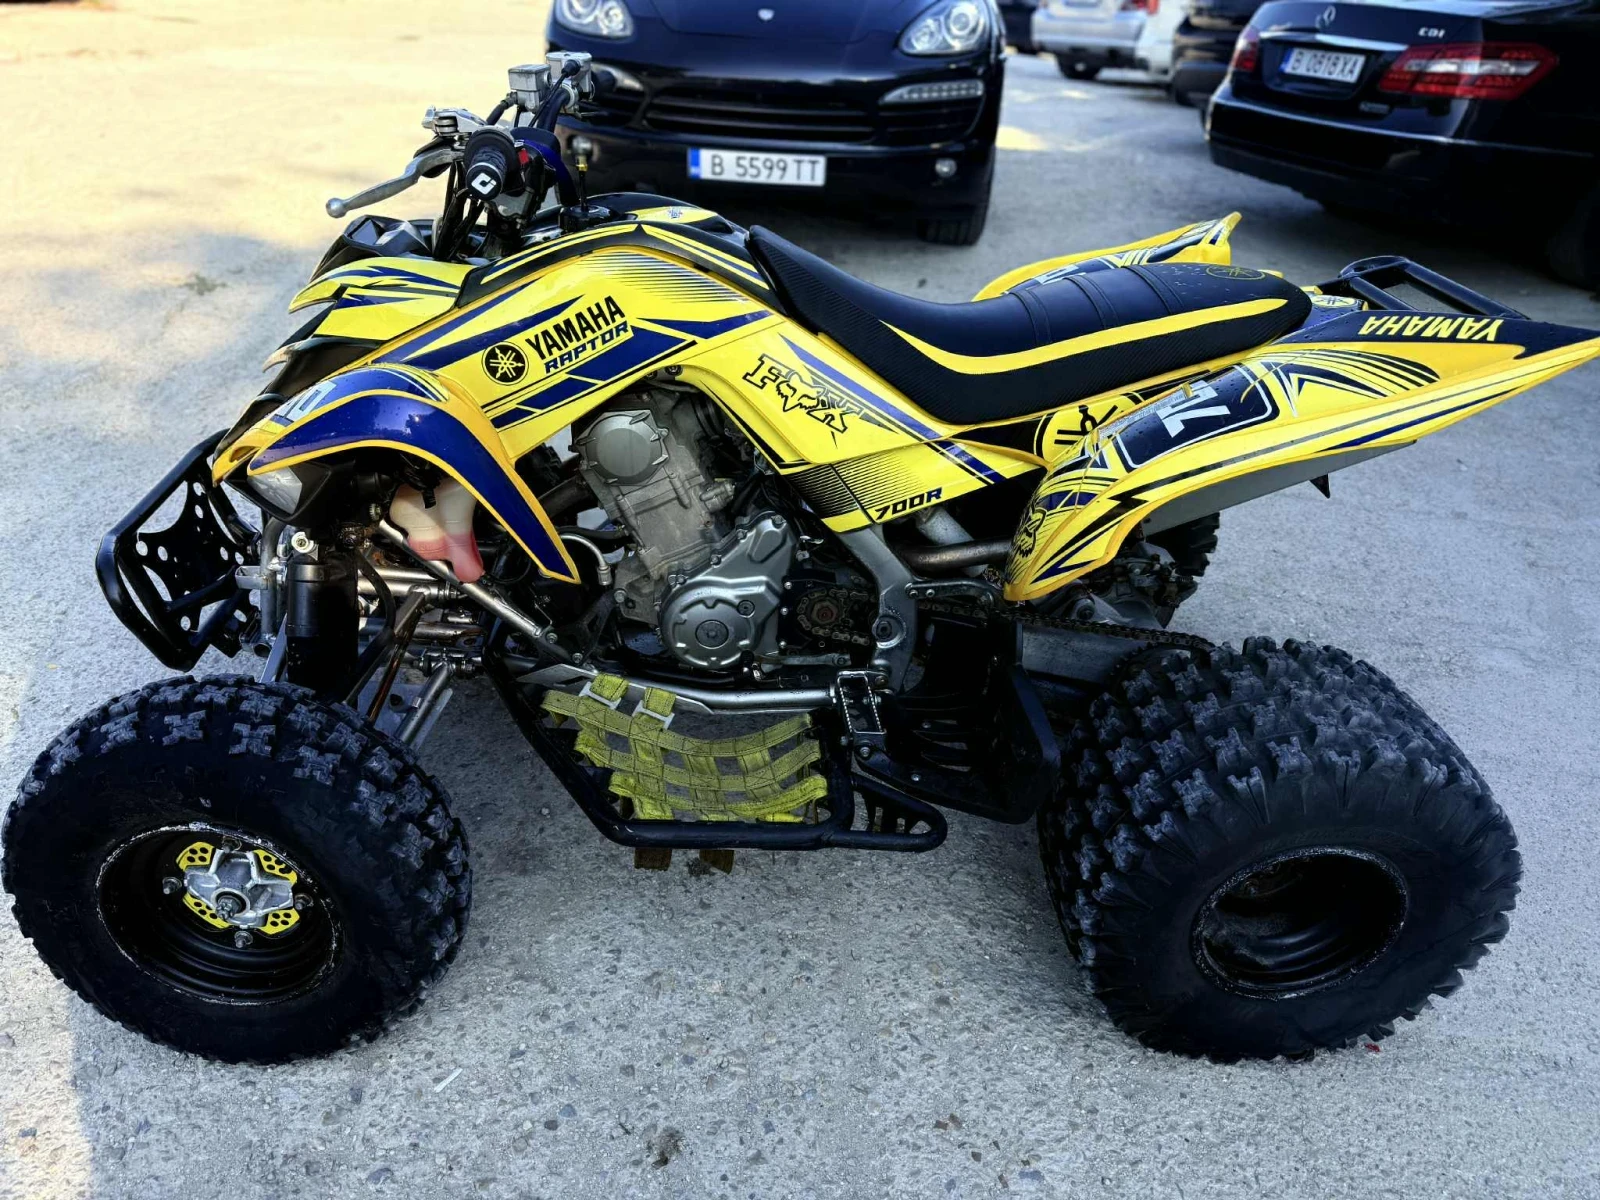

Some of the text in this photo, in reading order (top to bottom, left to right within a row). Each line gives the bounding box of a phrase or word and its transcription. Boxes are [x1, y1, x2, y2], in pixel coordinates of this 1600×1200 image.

[711, 153, 725, 177] B
[525, 295, 626, 360] YAMAHA
[544, 320, 629, 374] RAPTOR
[1357, 315, 1505, 342] YAMAHA
[742, 353, 864, 434] FOX
[874, 487, 943, 521] 700R
